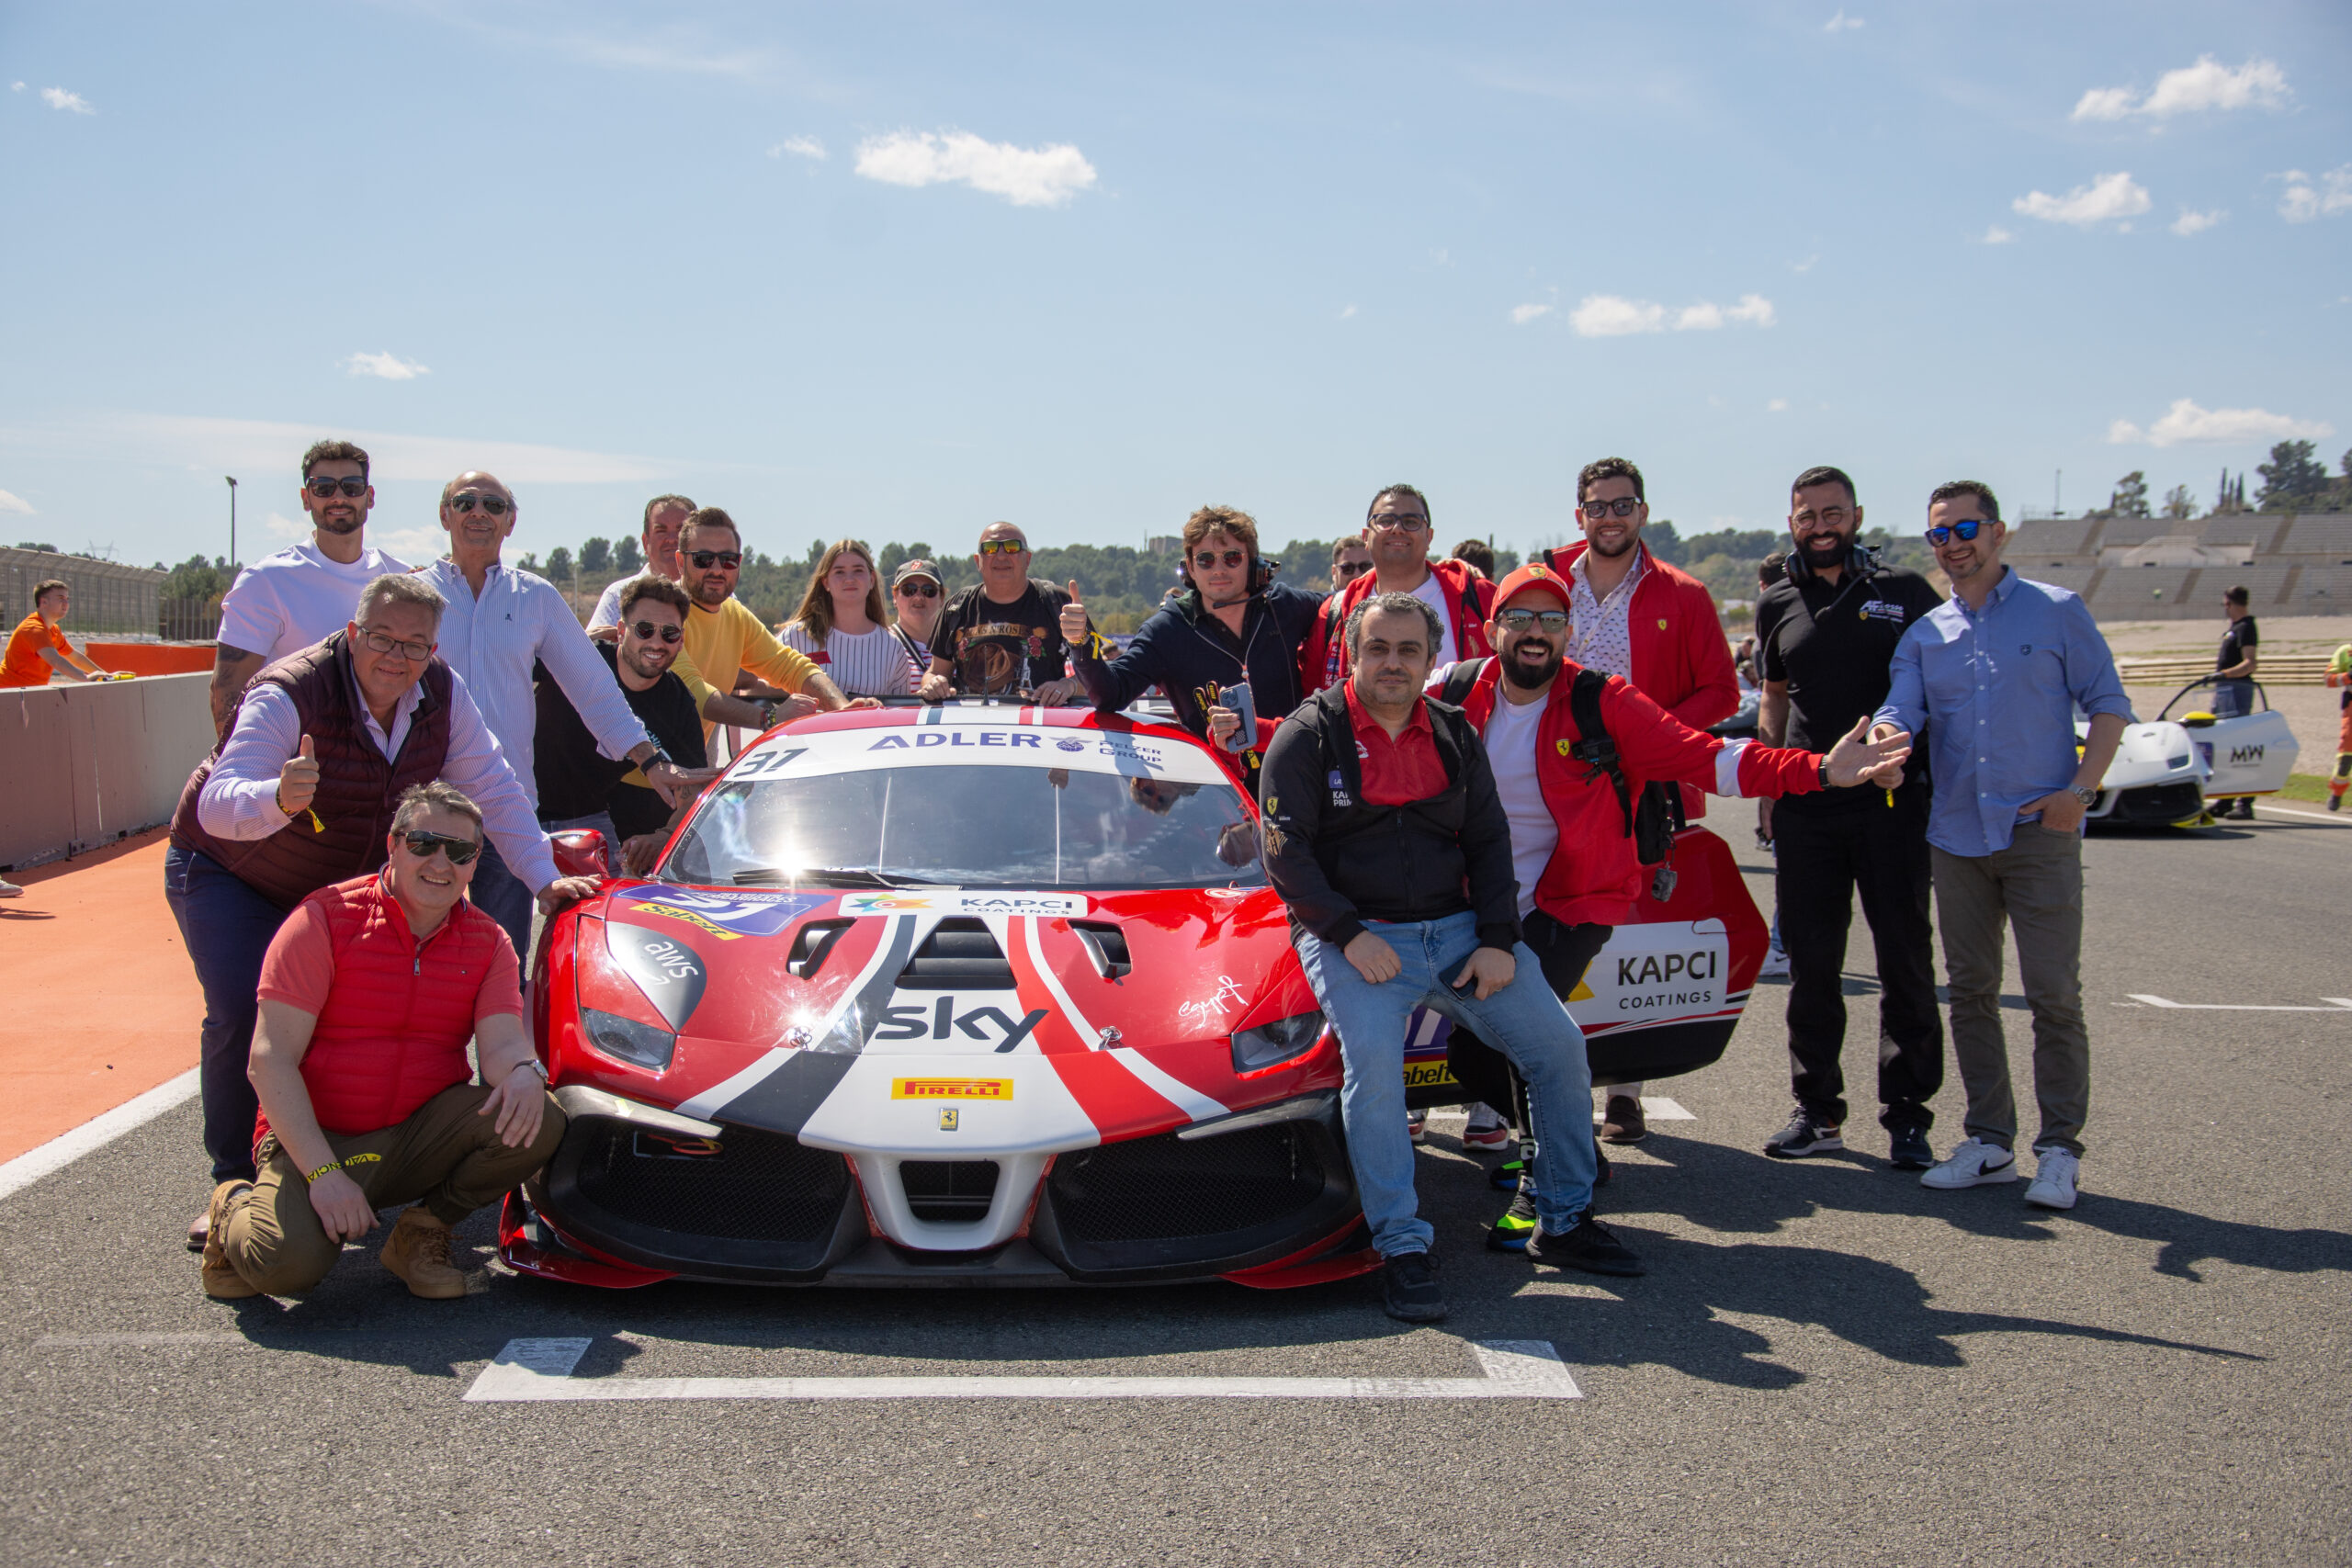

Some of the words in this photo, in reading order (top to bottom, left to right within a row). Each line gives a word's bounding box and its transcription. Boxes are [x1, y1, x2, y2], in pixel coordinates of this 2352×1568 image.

[866, 732, 1041, 751] ADLER
[1099, 739, 1161, 755] PELZER
[1099, 748, 1162, 762] GROUP
[2230, 744, 2265, 762] MW
[961, 898, 1072, 908] KAPCI
[644, 905, 729, 935] Sabelt
[645, 941, 698, 979] aws
[1618, 951, 1715, 986] KAPCI
[1619, 990, 1712, 1010] COATINGS
[875, 996, 1050, 1053] sky
[1403, 1063, 1451, 1086] abelt
[904, 1080, 1001, 1096] PIRELLI
[307, 1155, 368, 1182] VALNCIA
